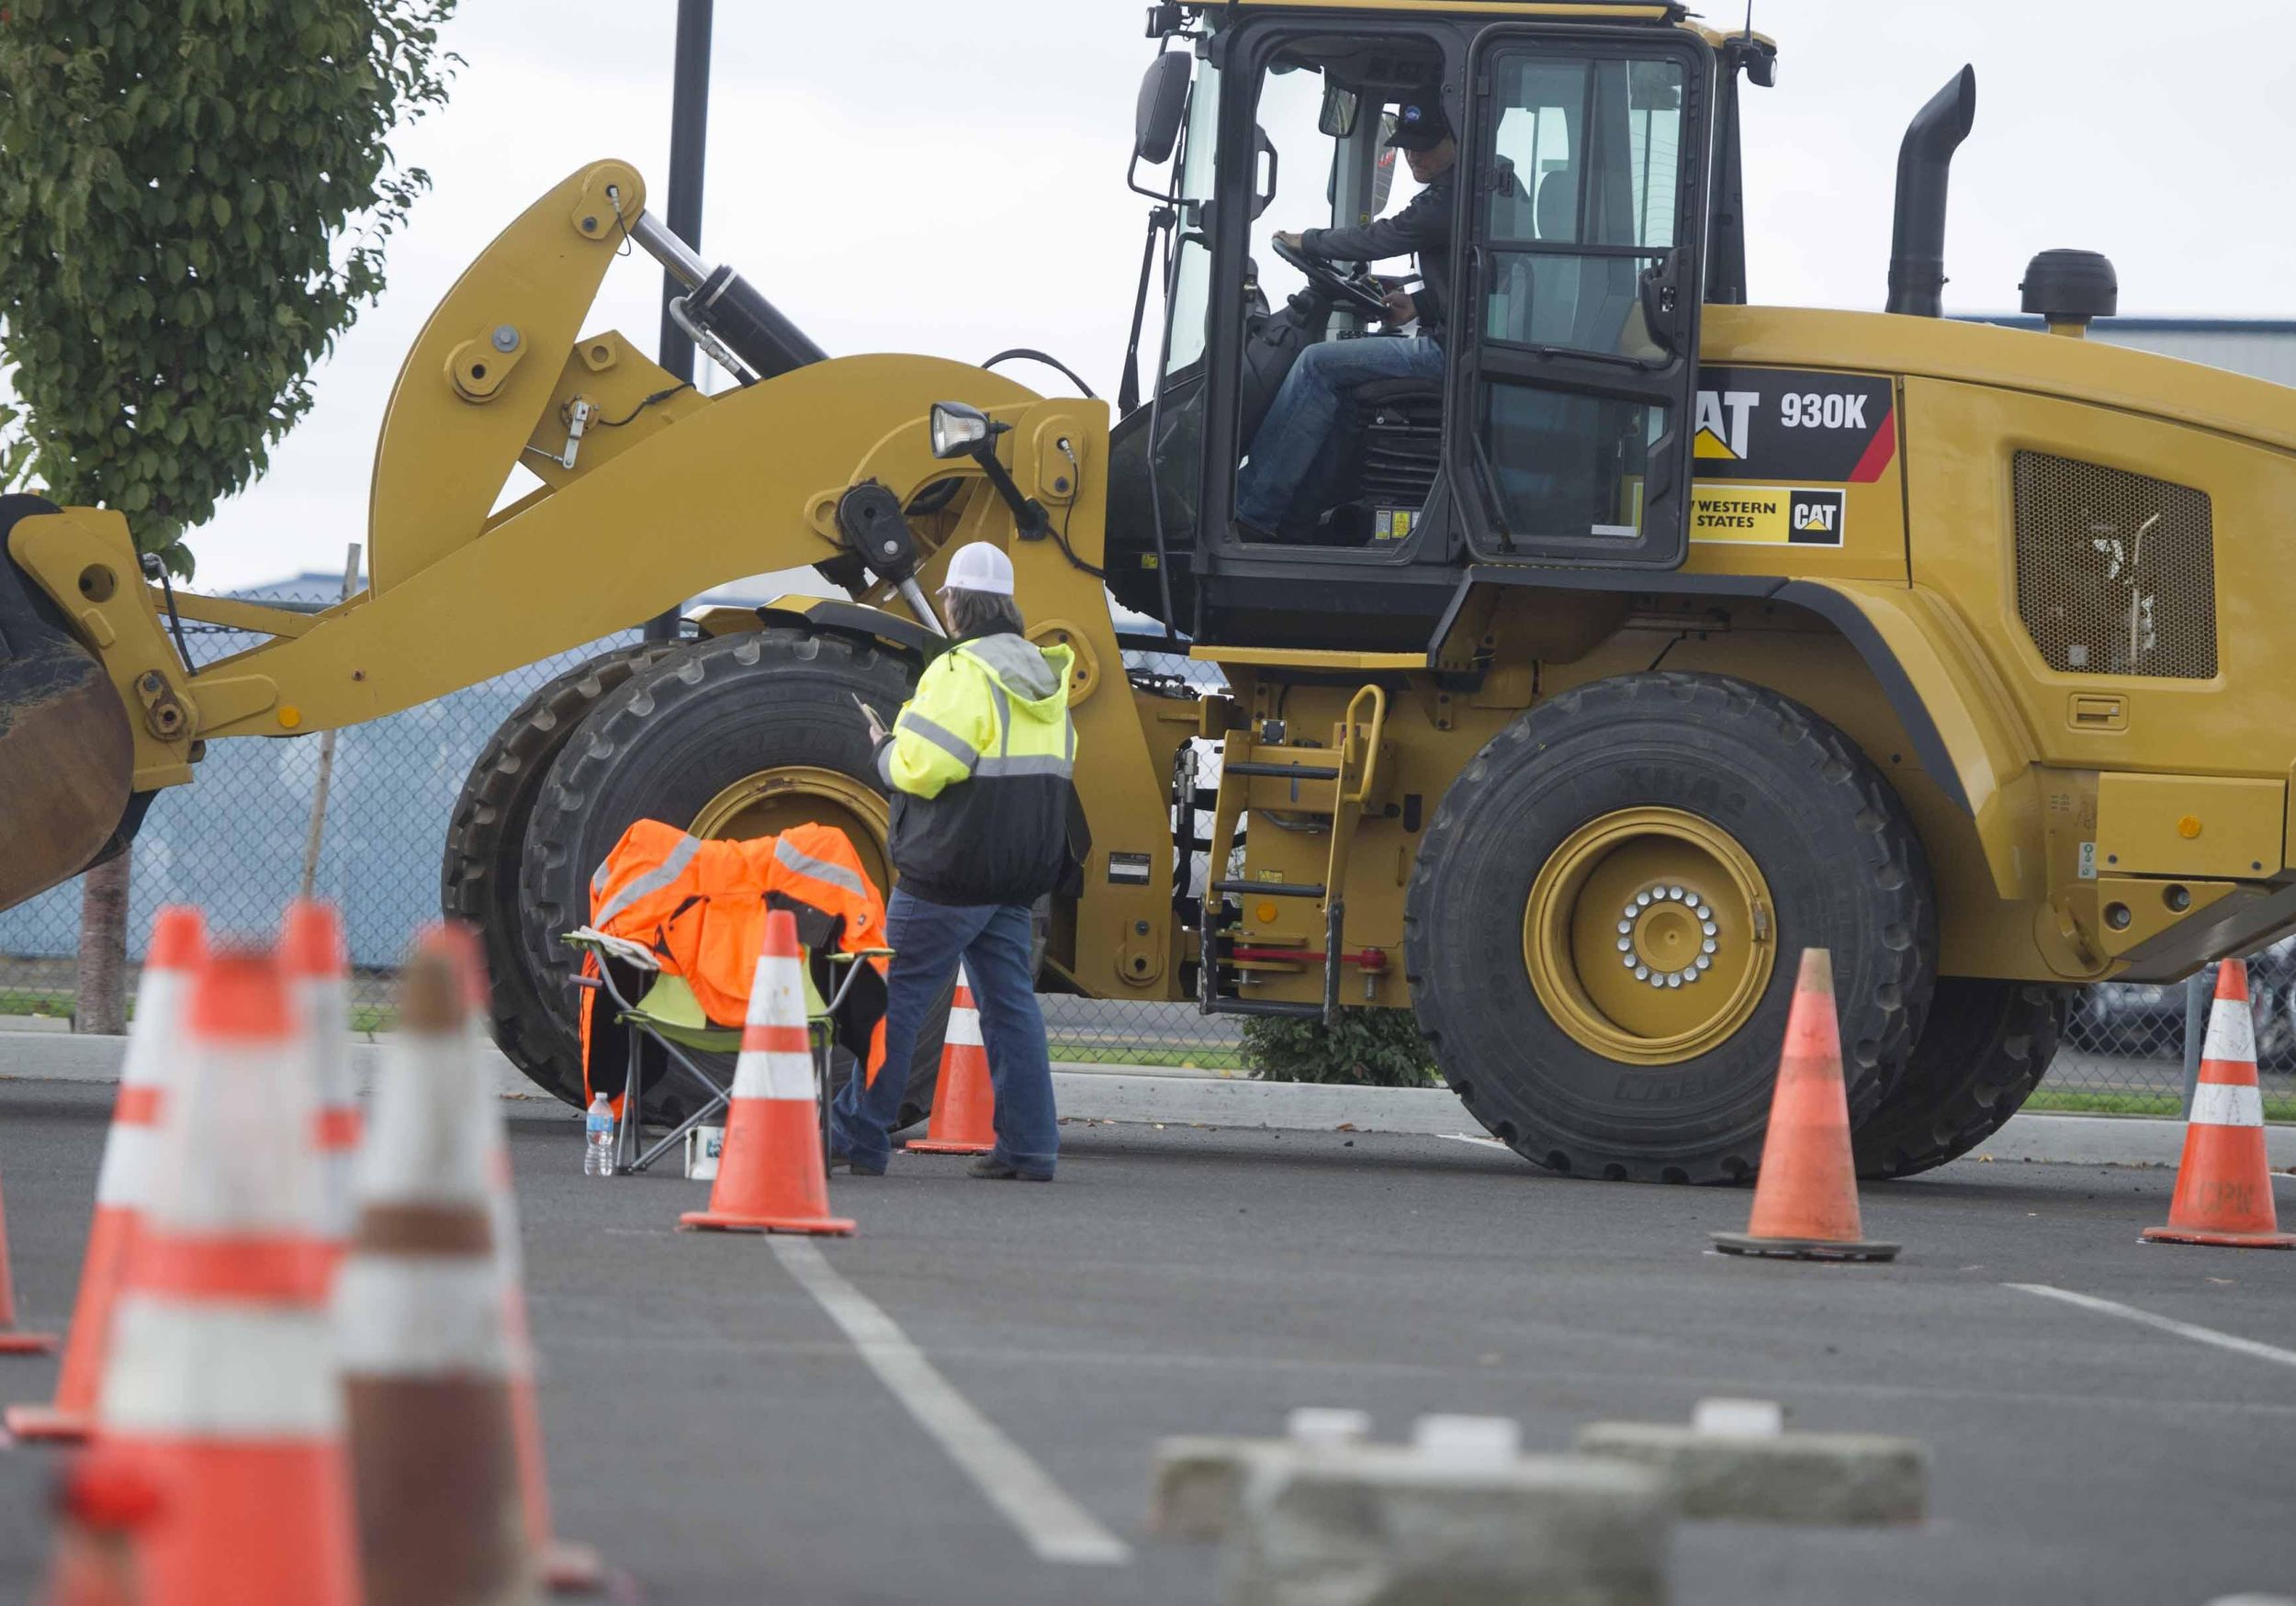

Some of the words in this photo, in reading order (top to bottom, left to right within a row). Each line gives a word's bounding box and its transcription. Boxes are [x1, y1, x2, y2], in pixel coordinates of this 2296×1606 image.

[1694, 390, 1760, 459] AT
[1781, 393, 1867, 429] 930K
[1698, 500, 1776, 513] WESTERN
[1794, 503, 1836, 530] CAT
[1697, 515, 1754, 528] STATES
